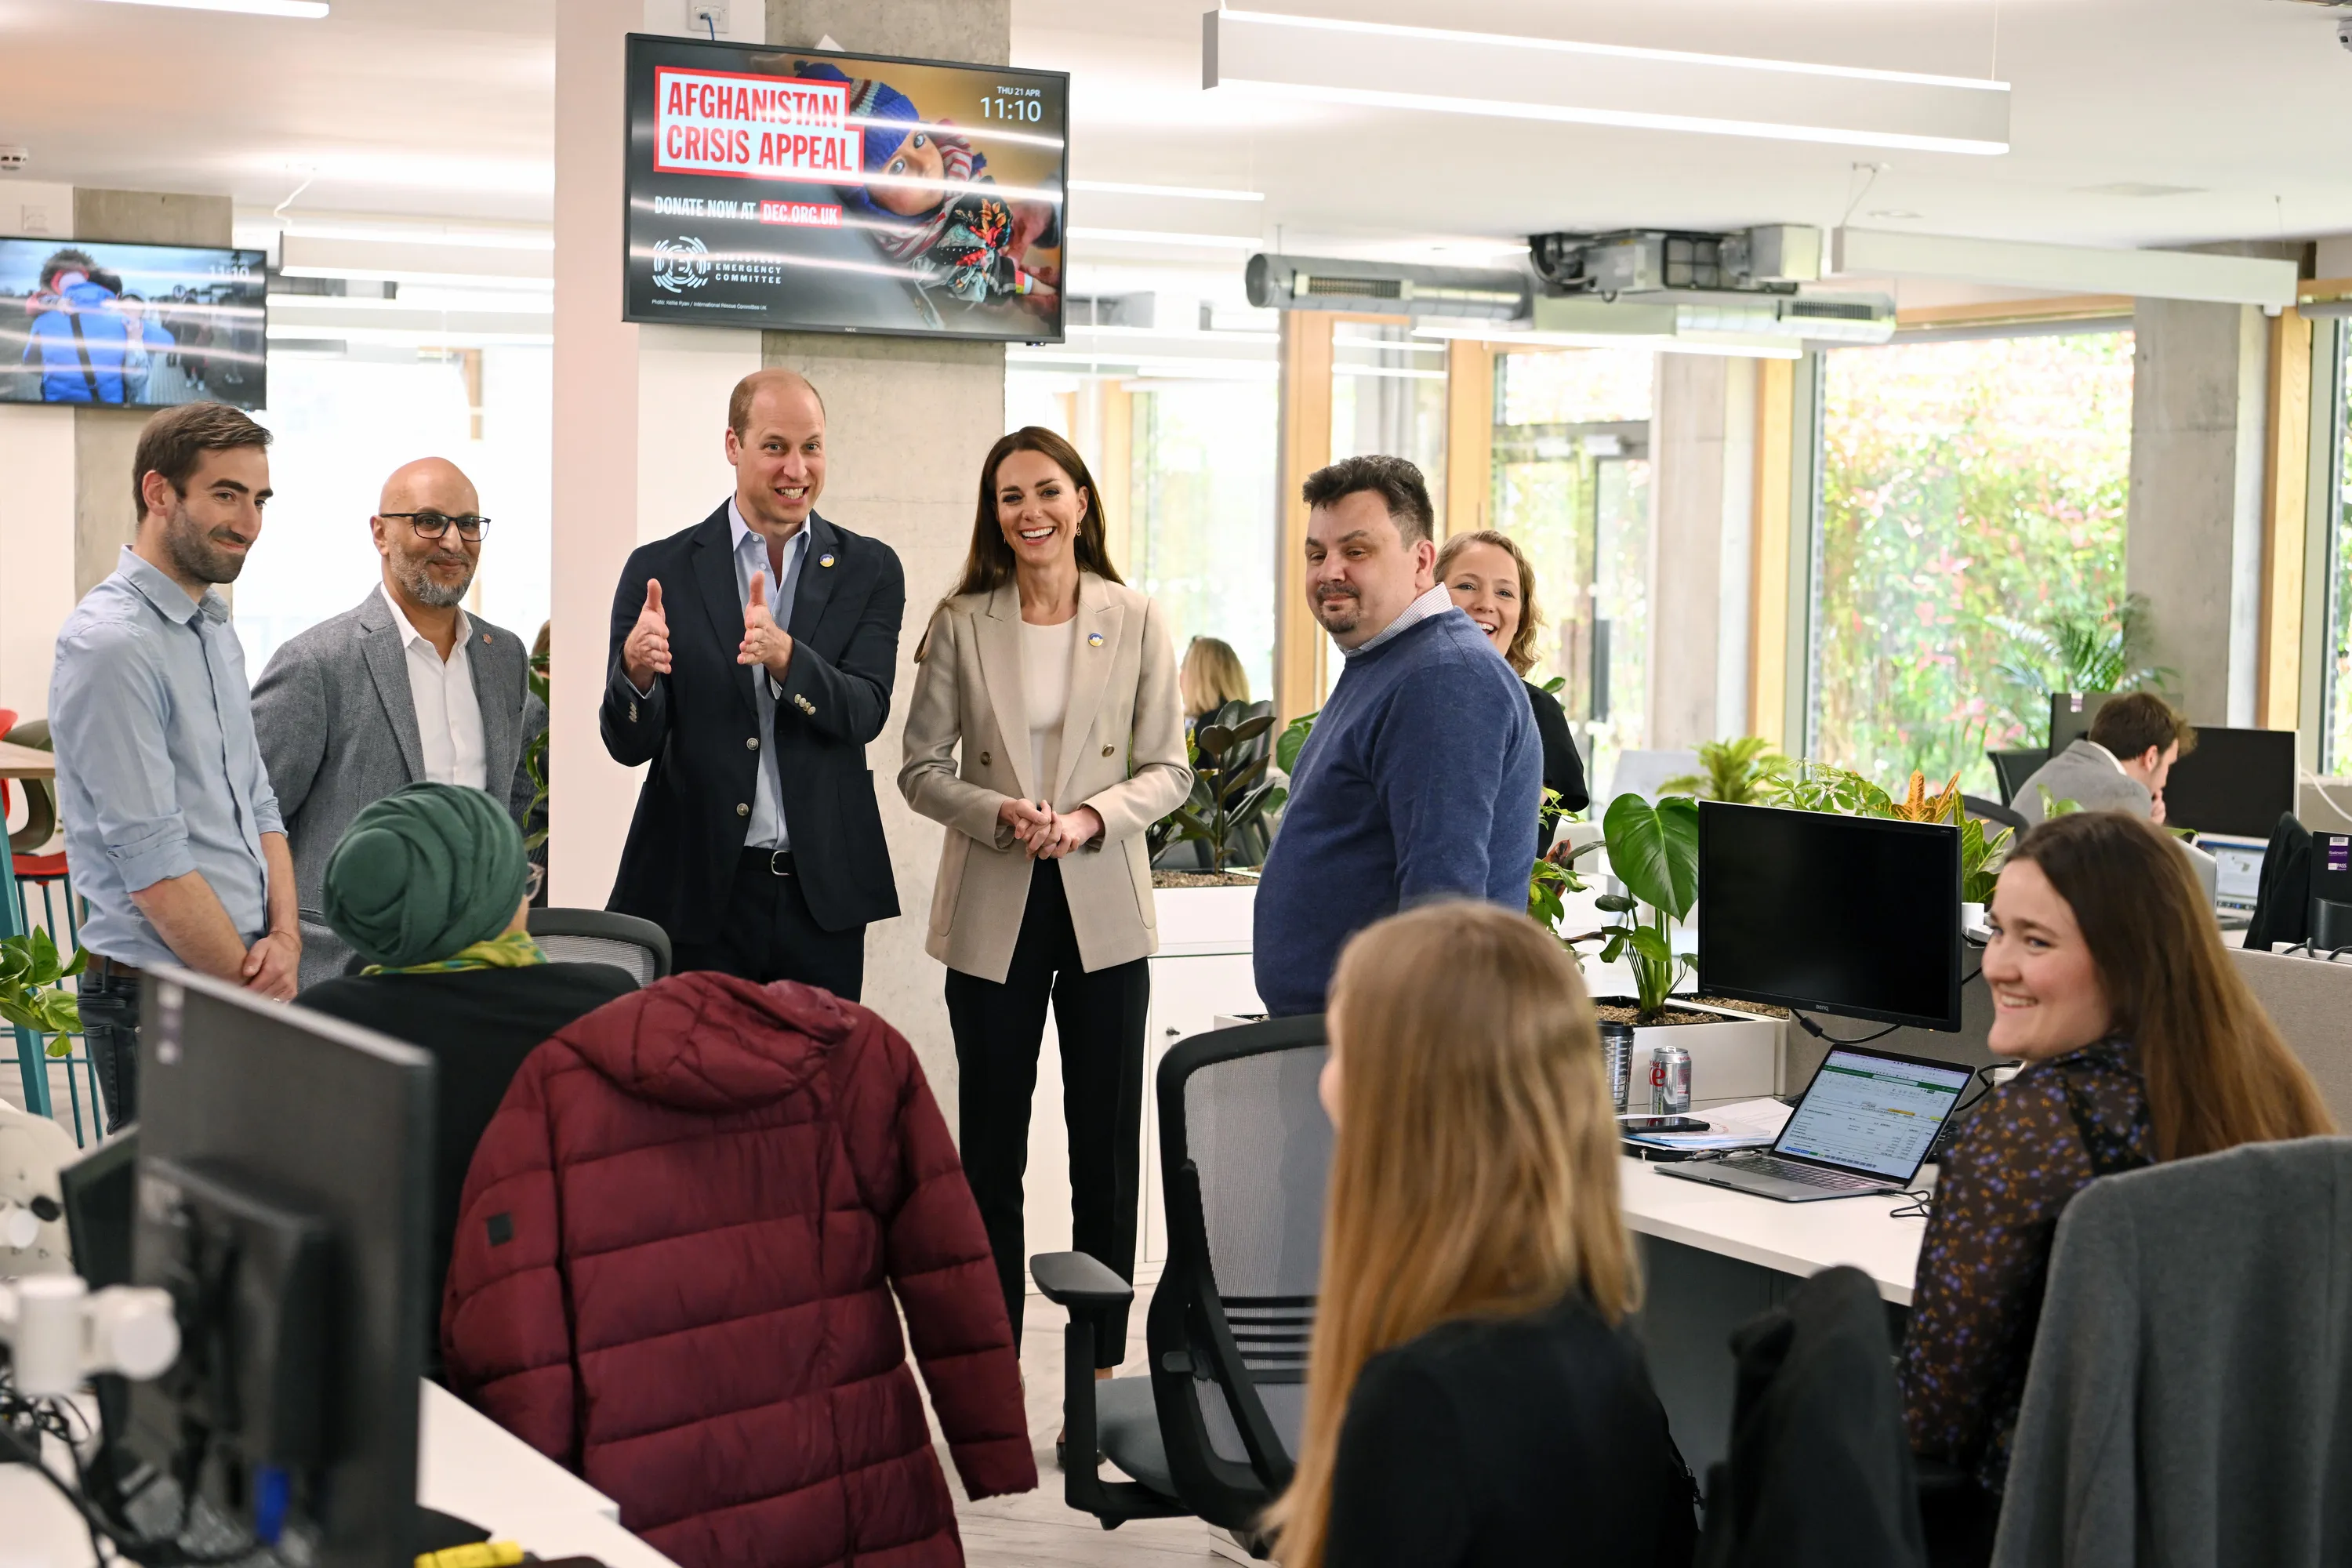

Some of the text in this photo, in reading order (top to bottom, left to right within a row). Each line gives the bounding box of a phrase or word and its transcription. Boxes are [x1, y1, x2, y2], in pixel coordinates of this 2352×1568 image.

[996, 85, 1041, 97] THU 21 APR
[667, 82, 837, 128] AFGHANISTAN
[980, 96, 1042, 122] 11:10
[666, 124, 852, 172] CRISIS APPEAL
[655, 195, 838, 226] DONATE NOW AT DEC.ORG.UK
[715, 263, 782, 274] EMERGENCY
[715, 274, 782, 285] COMMITTEE
